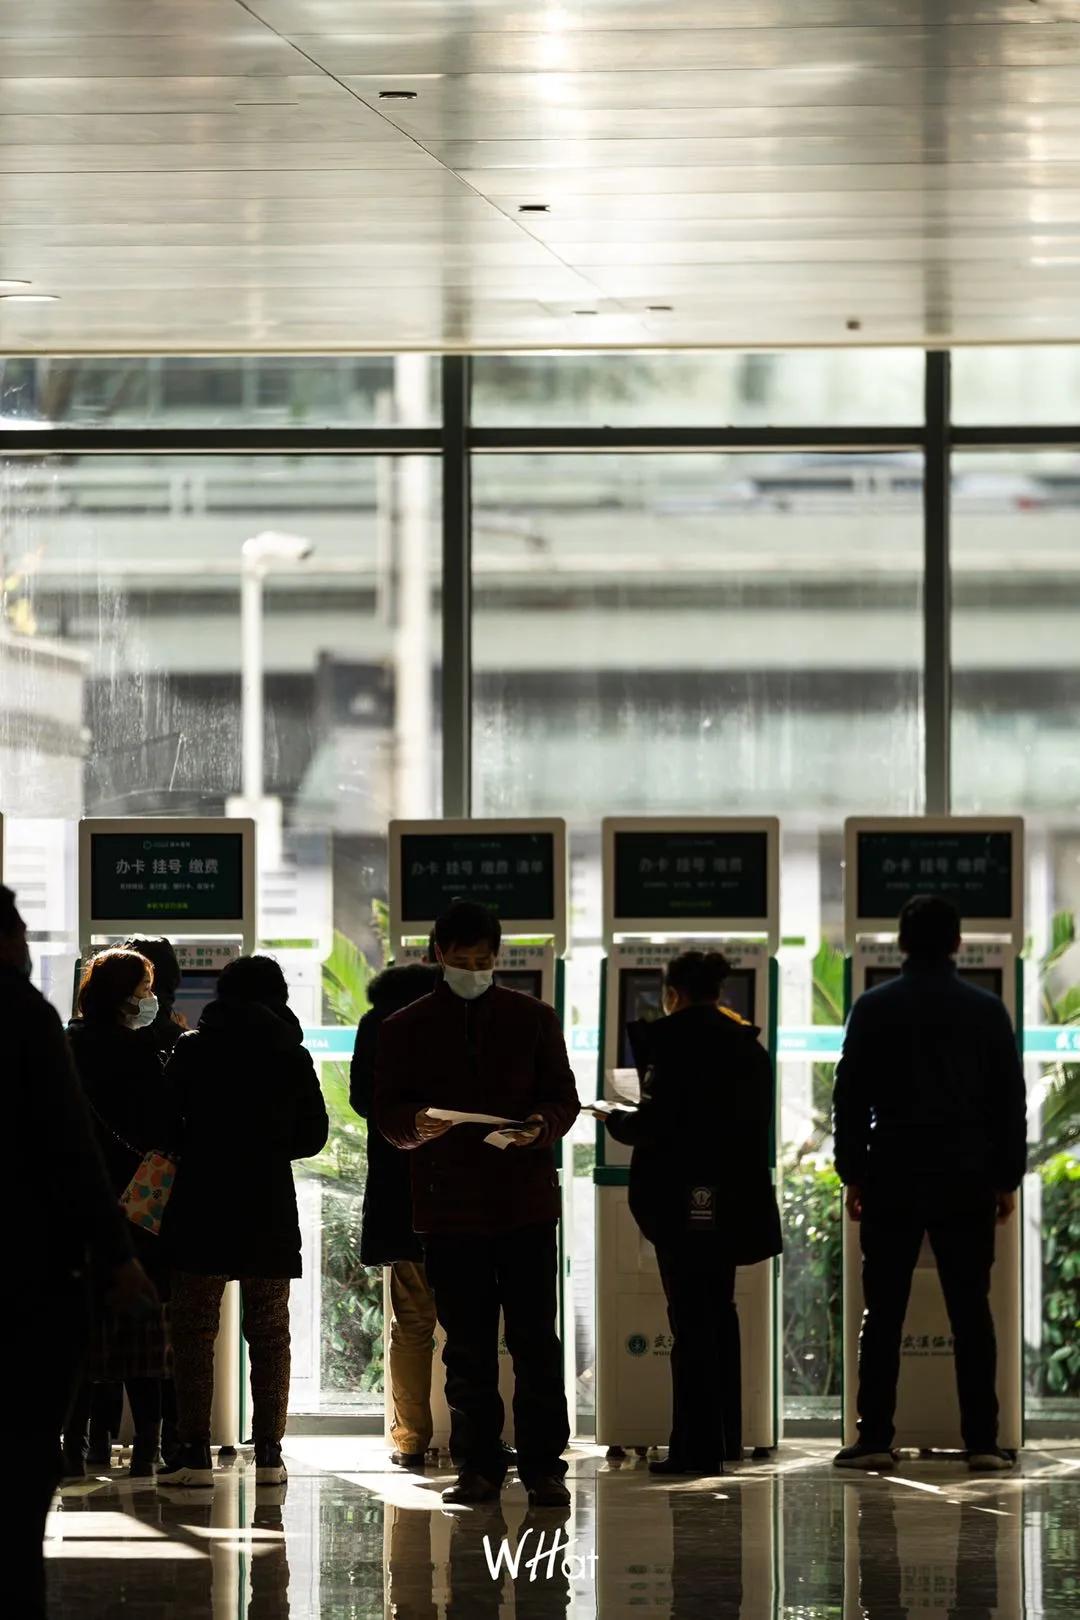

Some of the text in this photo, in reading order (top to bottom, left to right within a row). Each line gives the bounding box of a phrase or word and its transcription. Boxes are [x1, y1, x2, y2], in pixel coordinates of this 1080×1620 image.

[115, 858, 219, 875] 办卡 挂号 缴费
